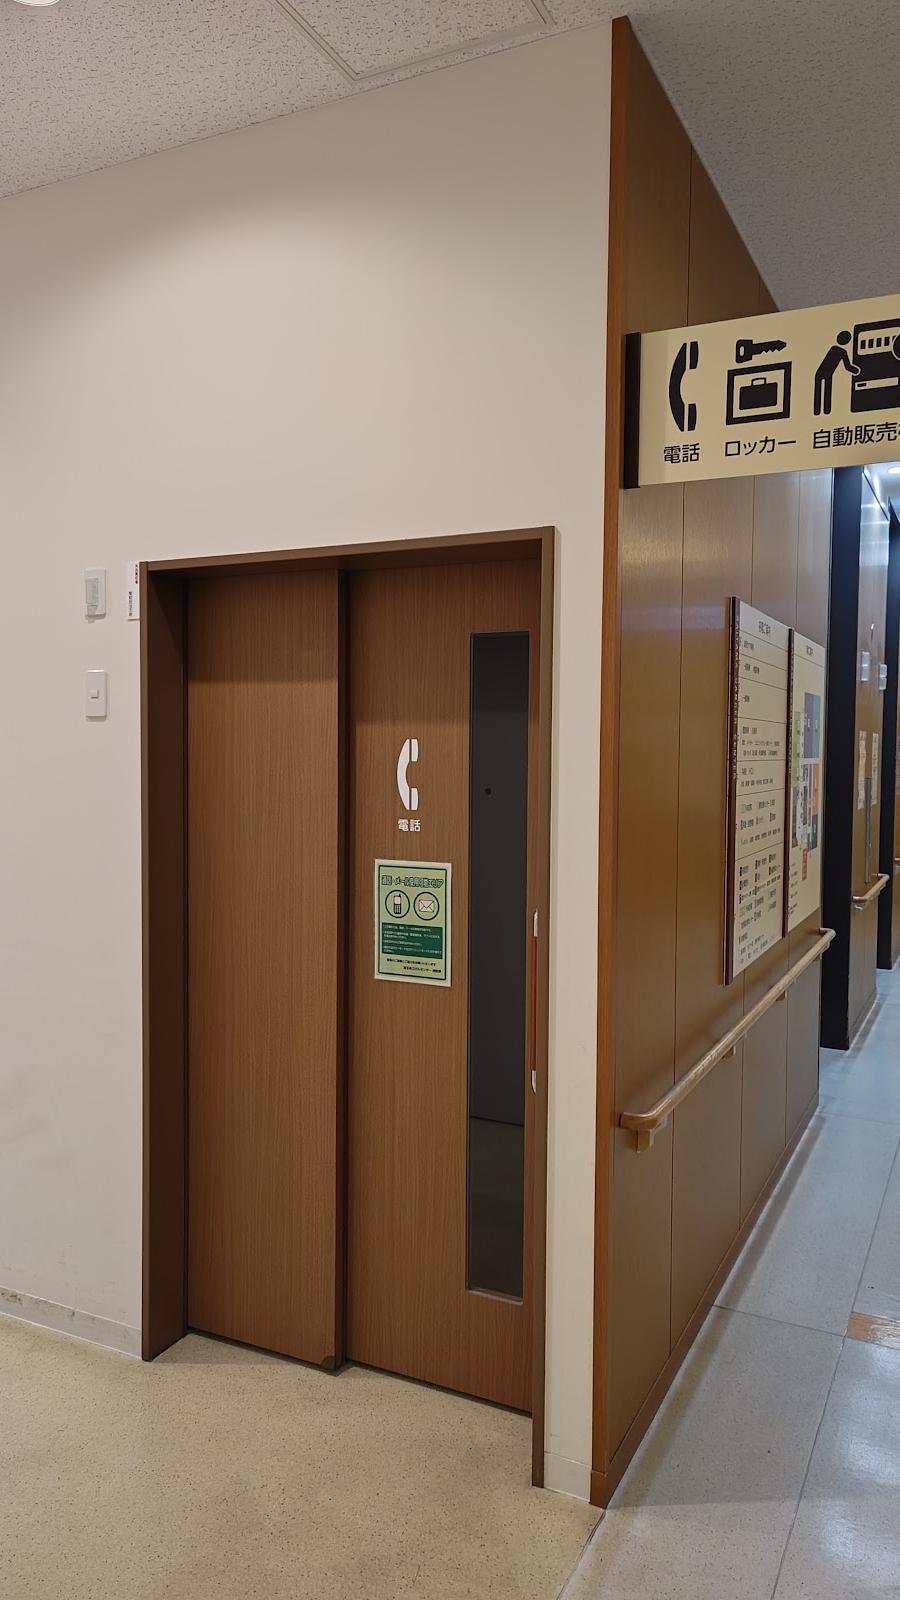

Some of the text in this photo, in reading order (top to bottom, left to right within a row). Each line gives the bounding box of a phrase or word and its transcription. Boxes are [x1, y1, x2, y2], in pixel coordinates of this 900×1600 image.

[812, 422, 900, 449] 自動販売
[663, 442, 701, 464] 電話
[724, 436, 797, 457] ロッカー
[397, 818, 421, 832] 電話
